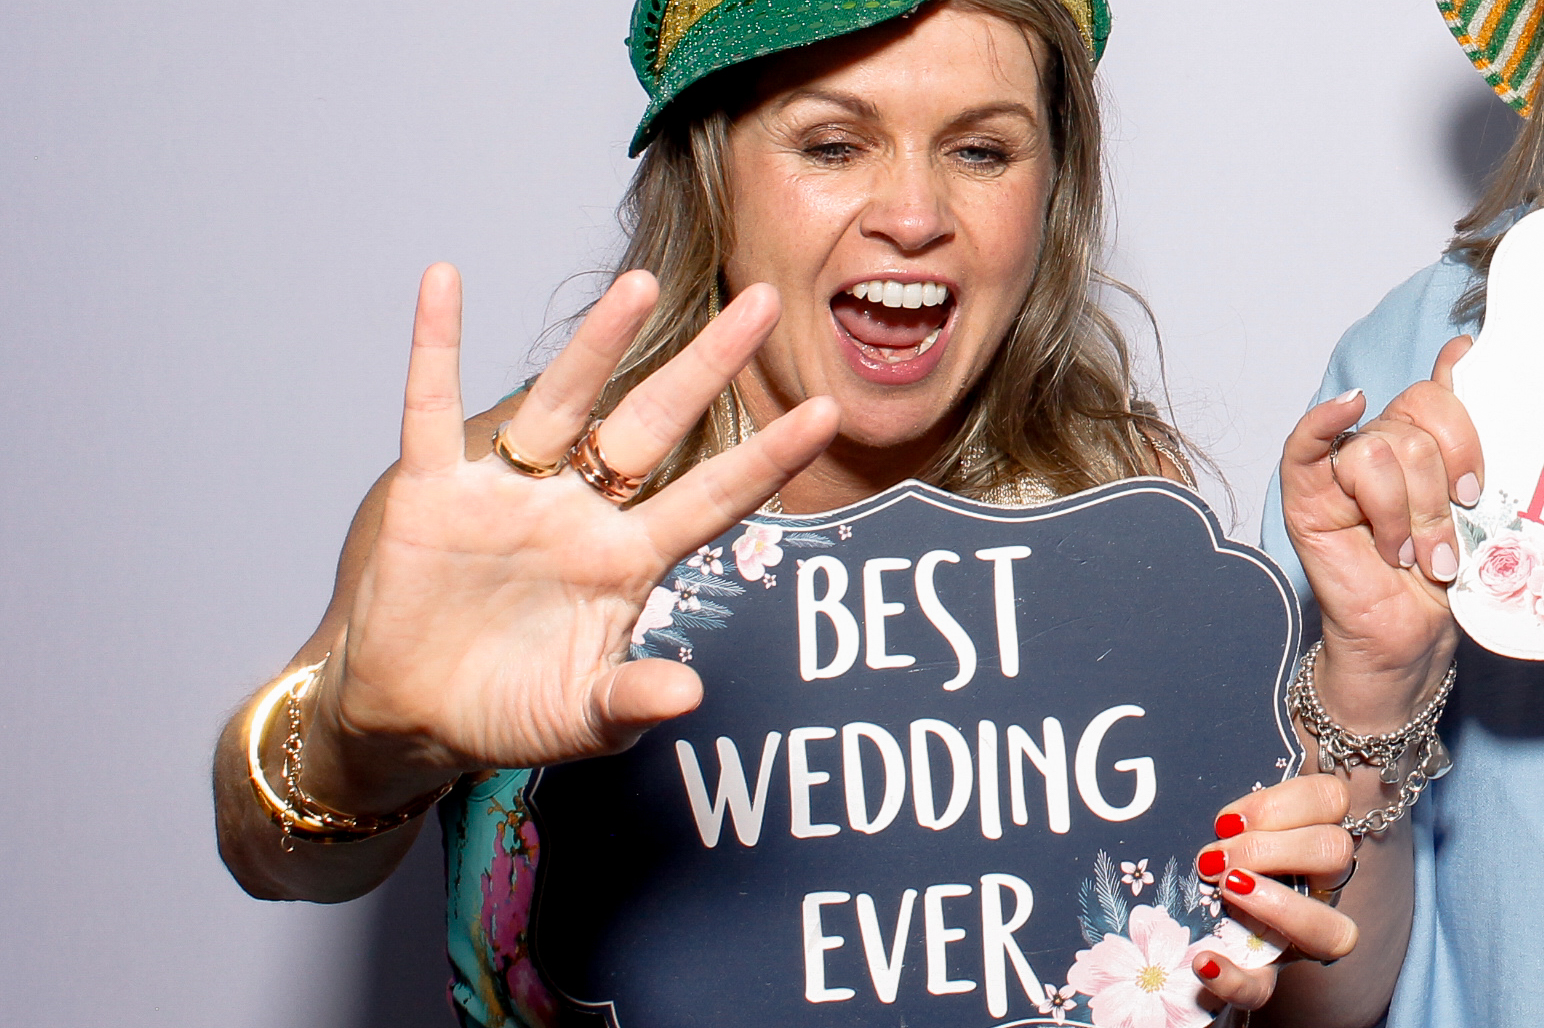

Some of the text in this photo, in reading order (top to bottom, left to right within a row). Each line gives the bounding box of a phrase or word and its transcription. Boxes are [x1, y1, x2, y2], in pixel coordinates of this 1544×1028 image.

[798, 545, 1032, 692] BEST
[674, 704, 1157, 849] WEDDING
[801, 873, 1047, 1018] EVER
